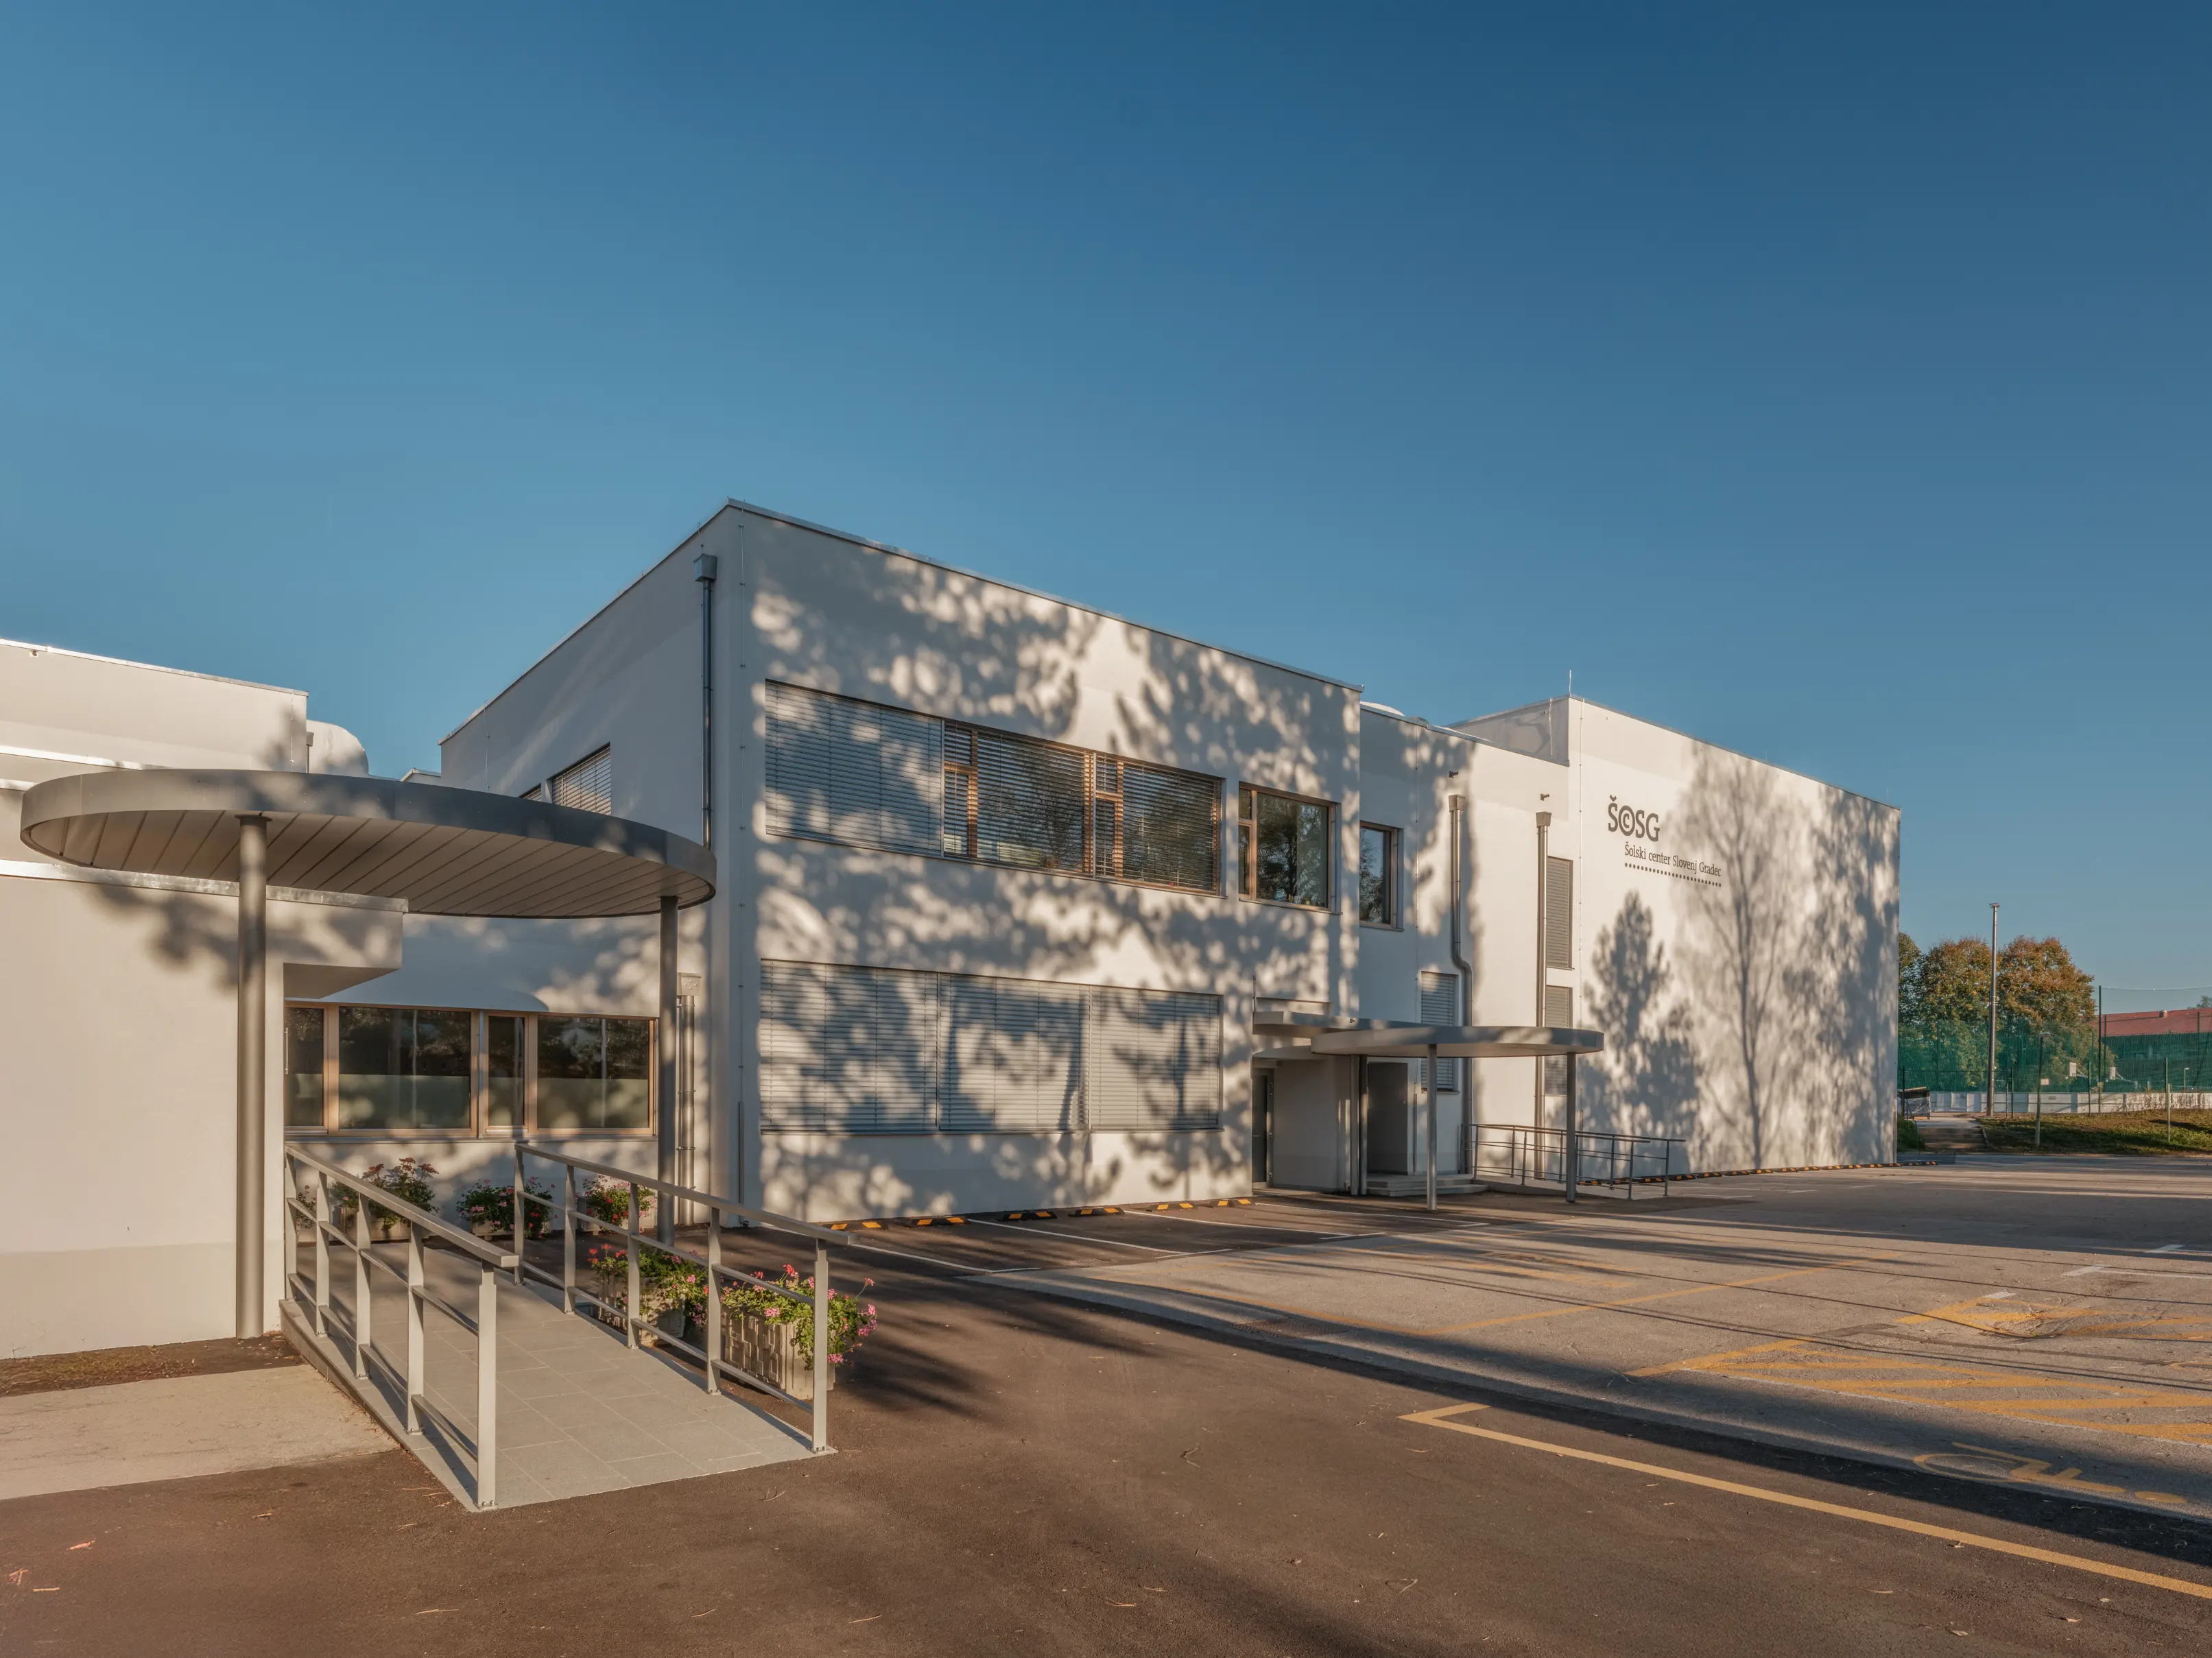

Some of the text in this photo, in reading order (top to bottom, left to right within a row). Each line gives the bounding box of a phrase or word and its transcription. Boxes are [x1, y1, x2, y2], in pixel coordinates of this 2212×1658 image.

[1625, 841, 1722, 877] Šolski center Slovenj Gradec
